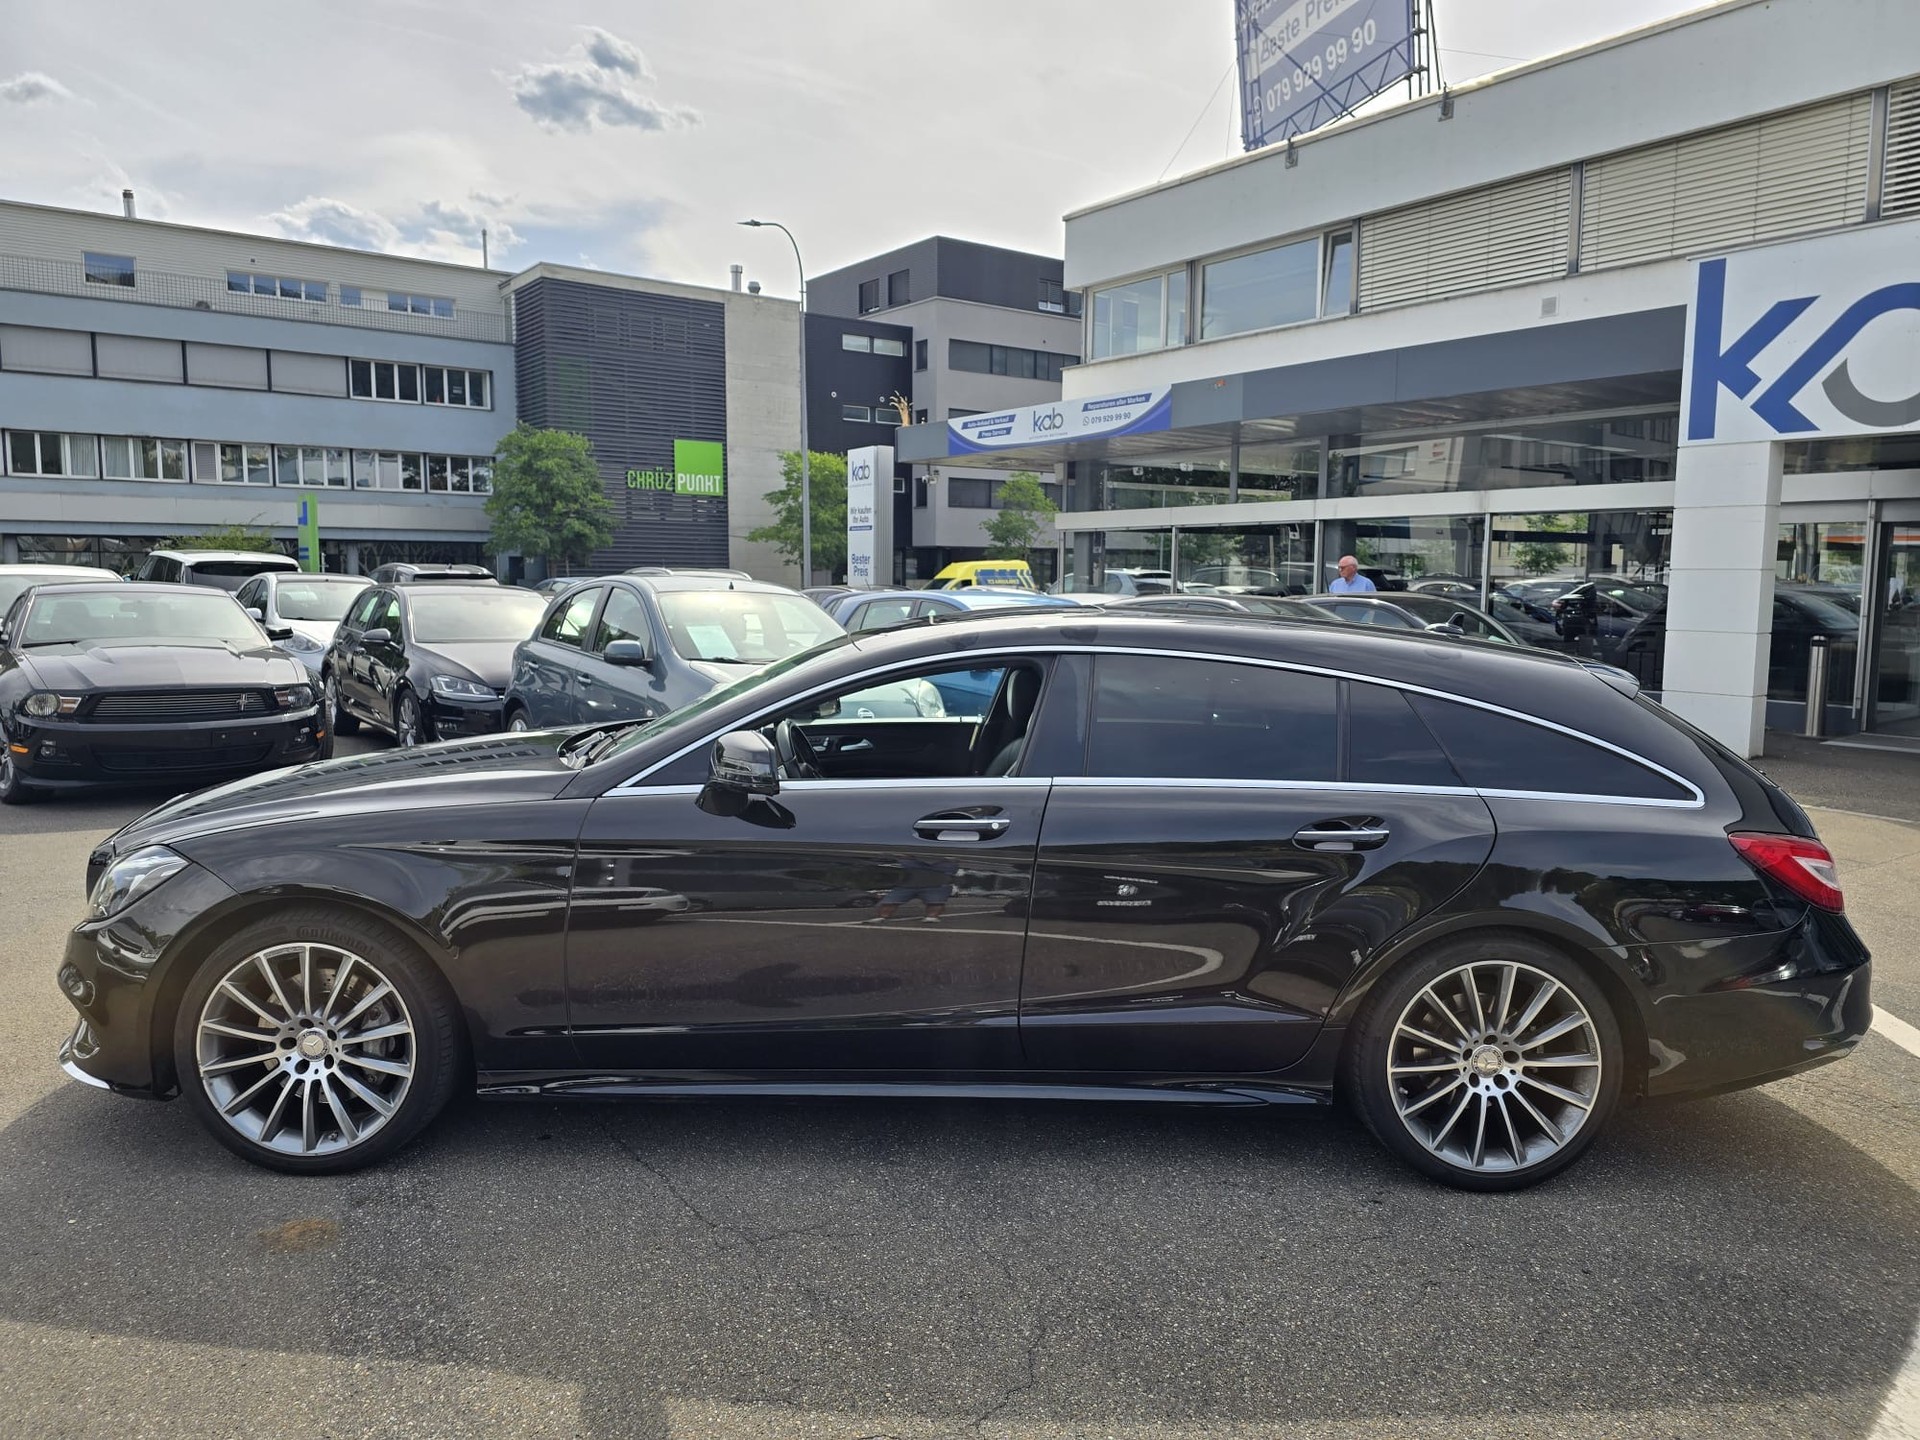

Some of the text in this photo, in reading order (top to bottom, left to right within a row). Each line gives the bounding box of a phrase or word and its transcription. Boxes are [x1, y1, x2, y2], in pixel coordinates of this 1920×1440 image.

[1260, 17, 1301, 63] Beste
[1305, 0, 1345, 28] Pre
[1267, 19, 1376, 112] 079 929 99 90
[1033, 407, 1064, 432] kab
[1091, 416, 1102, 424] 079
[1103, 414, 1114, 422] 929
[627, 466, 721, 493] CHRÜZ PUNKT
[851, 459, 870, 481] kab
[851, 554, 870, 565] Bester
[853, 566, 868, 577] Preis
